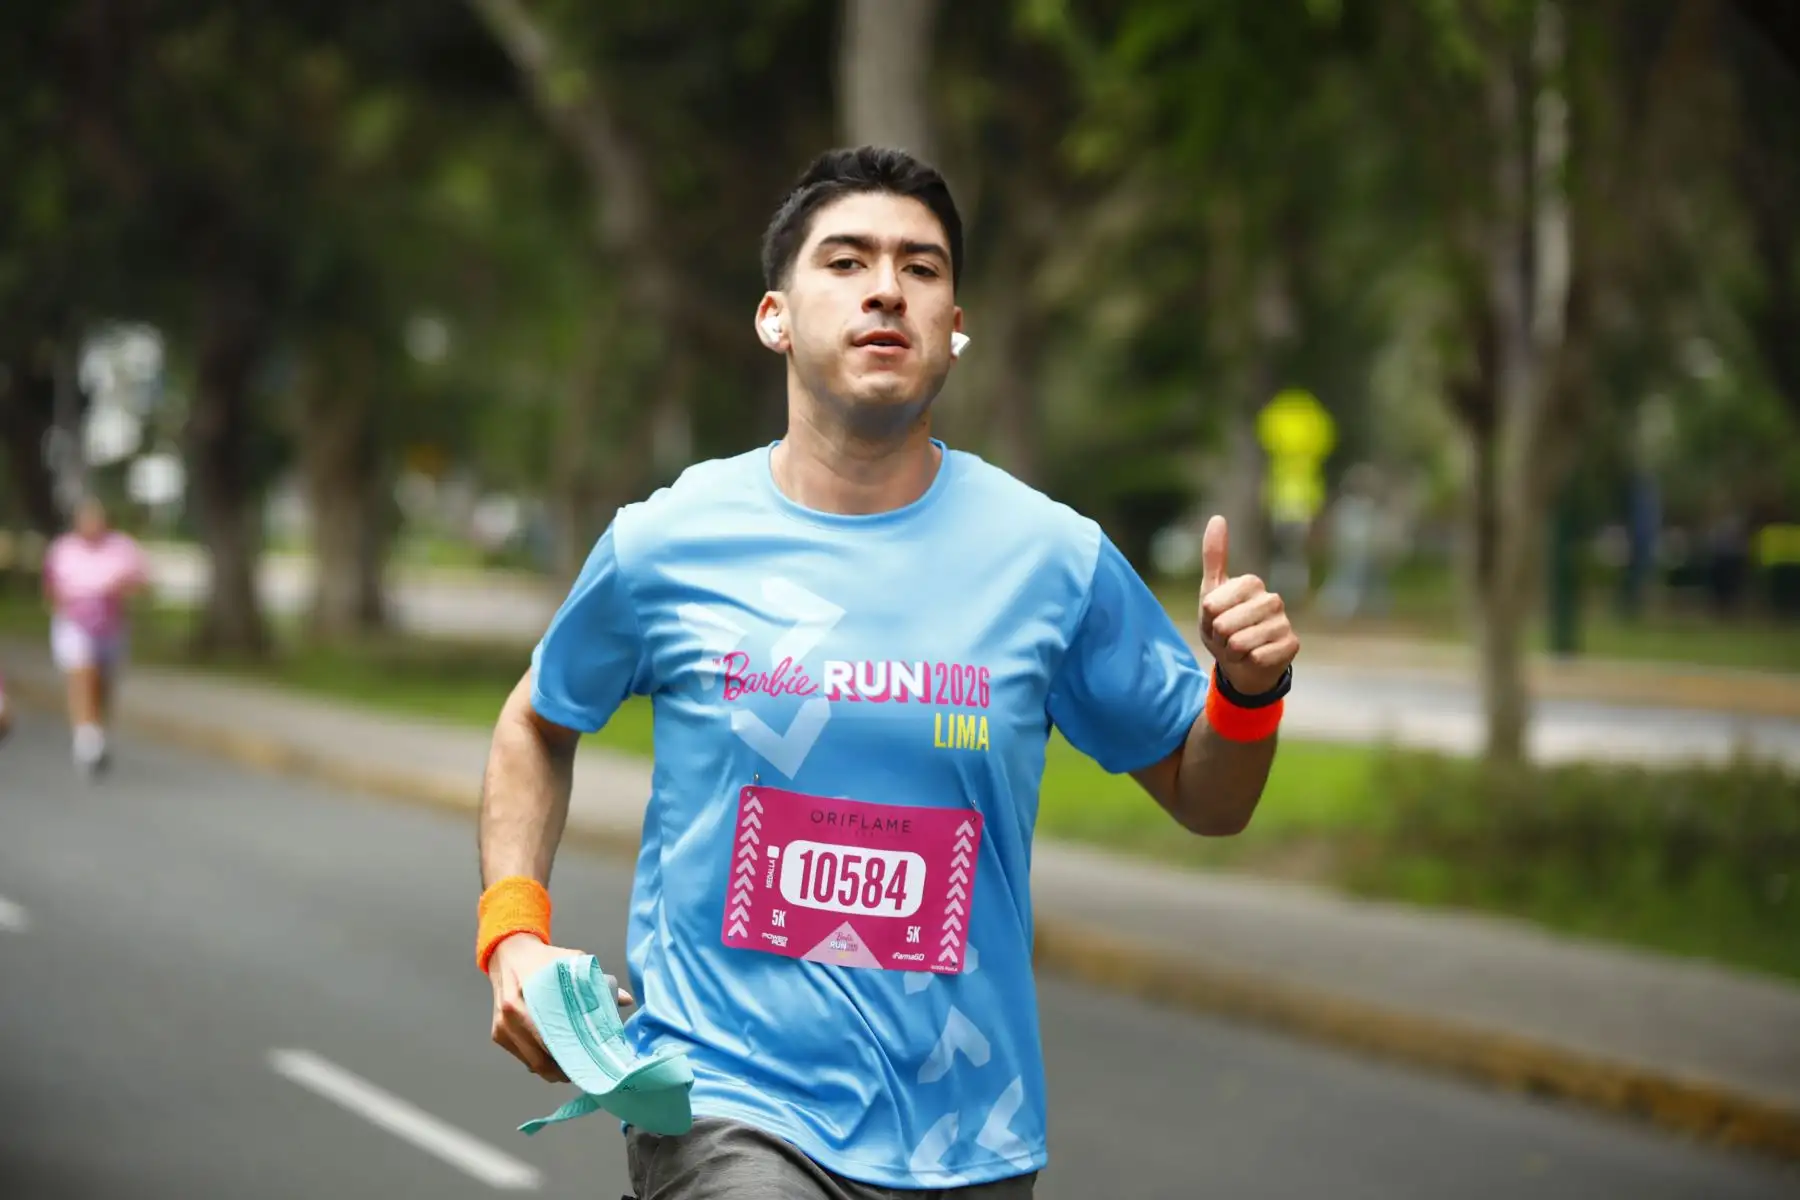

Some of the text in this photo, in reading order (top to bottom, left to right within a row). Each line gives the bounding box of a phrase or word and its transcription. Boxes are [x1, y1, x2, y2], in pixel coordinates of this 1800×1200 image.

[723, 651, 819, 700] Barbie
[823, 660, 931, 703] RUN
[935, 662, 990, 708] 2026
[934, 712, 989, 750] LIMA
[810, 809, 912, 834] ORIFLAME
[799, 849, 910, 911] 10584
[772, 909, 786, 928] 5K
[906, 925, 921, 943] 5K
